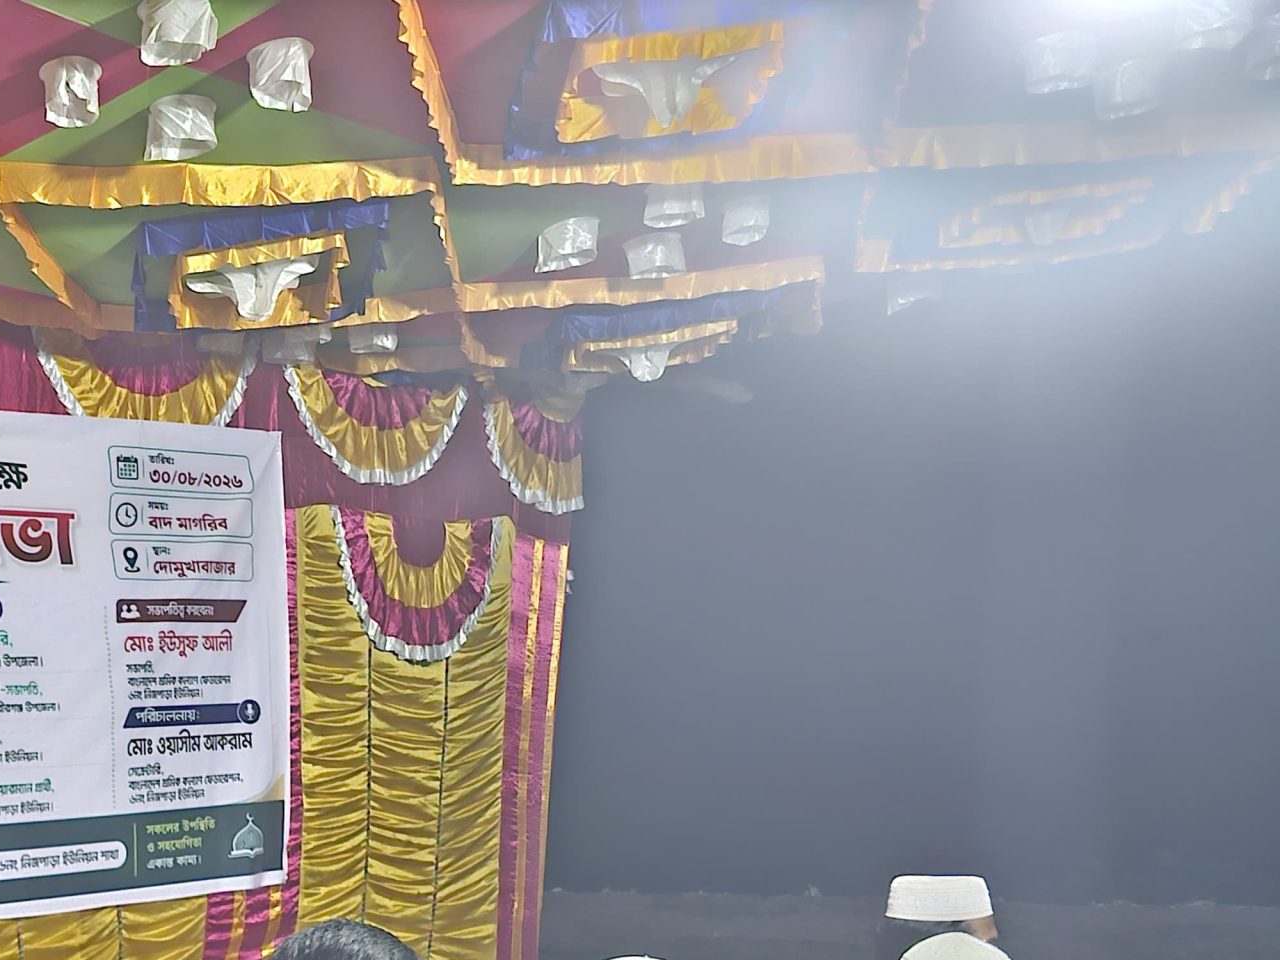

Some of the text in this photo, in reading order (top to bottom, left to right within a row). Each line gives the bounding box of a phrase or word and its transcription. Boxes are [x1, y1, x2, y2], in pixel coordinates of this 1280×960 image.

[149, 469, 243, 489] ৩০/০৮/২০২৬
[148, 514, 228, 531] বাদ মাগরিব
[153, 560, 236, 578] দোমুখাবাজার
[124, 629, 233, 658] মোঃ ইউসুফ আলী
[127, 729, 253, 757] মোঃ ওয়াসীম আকরাম
